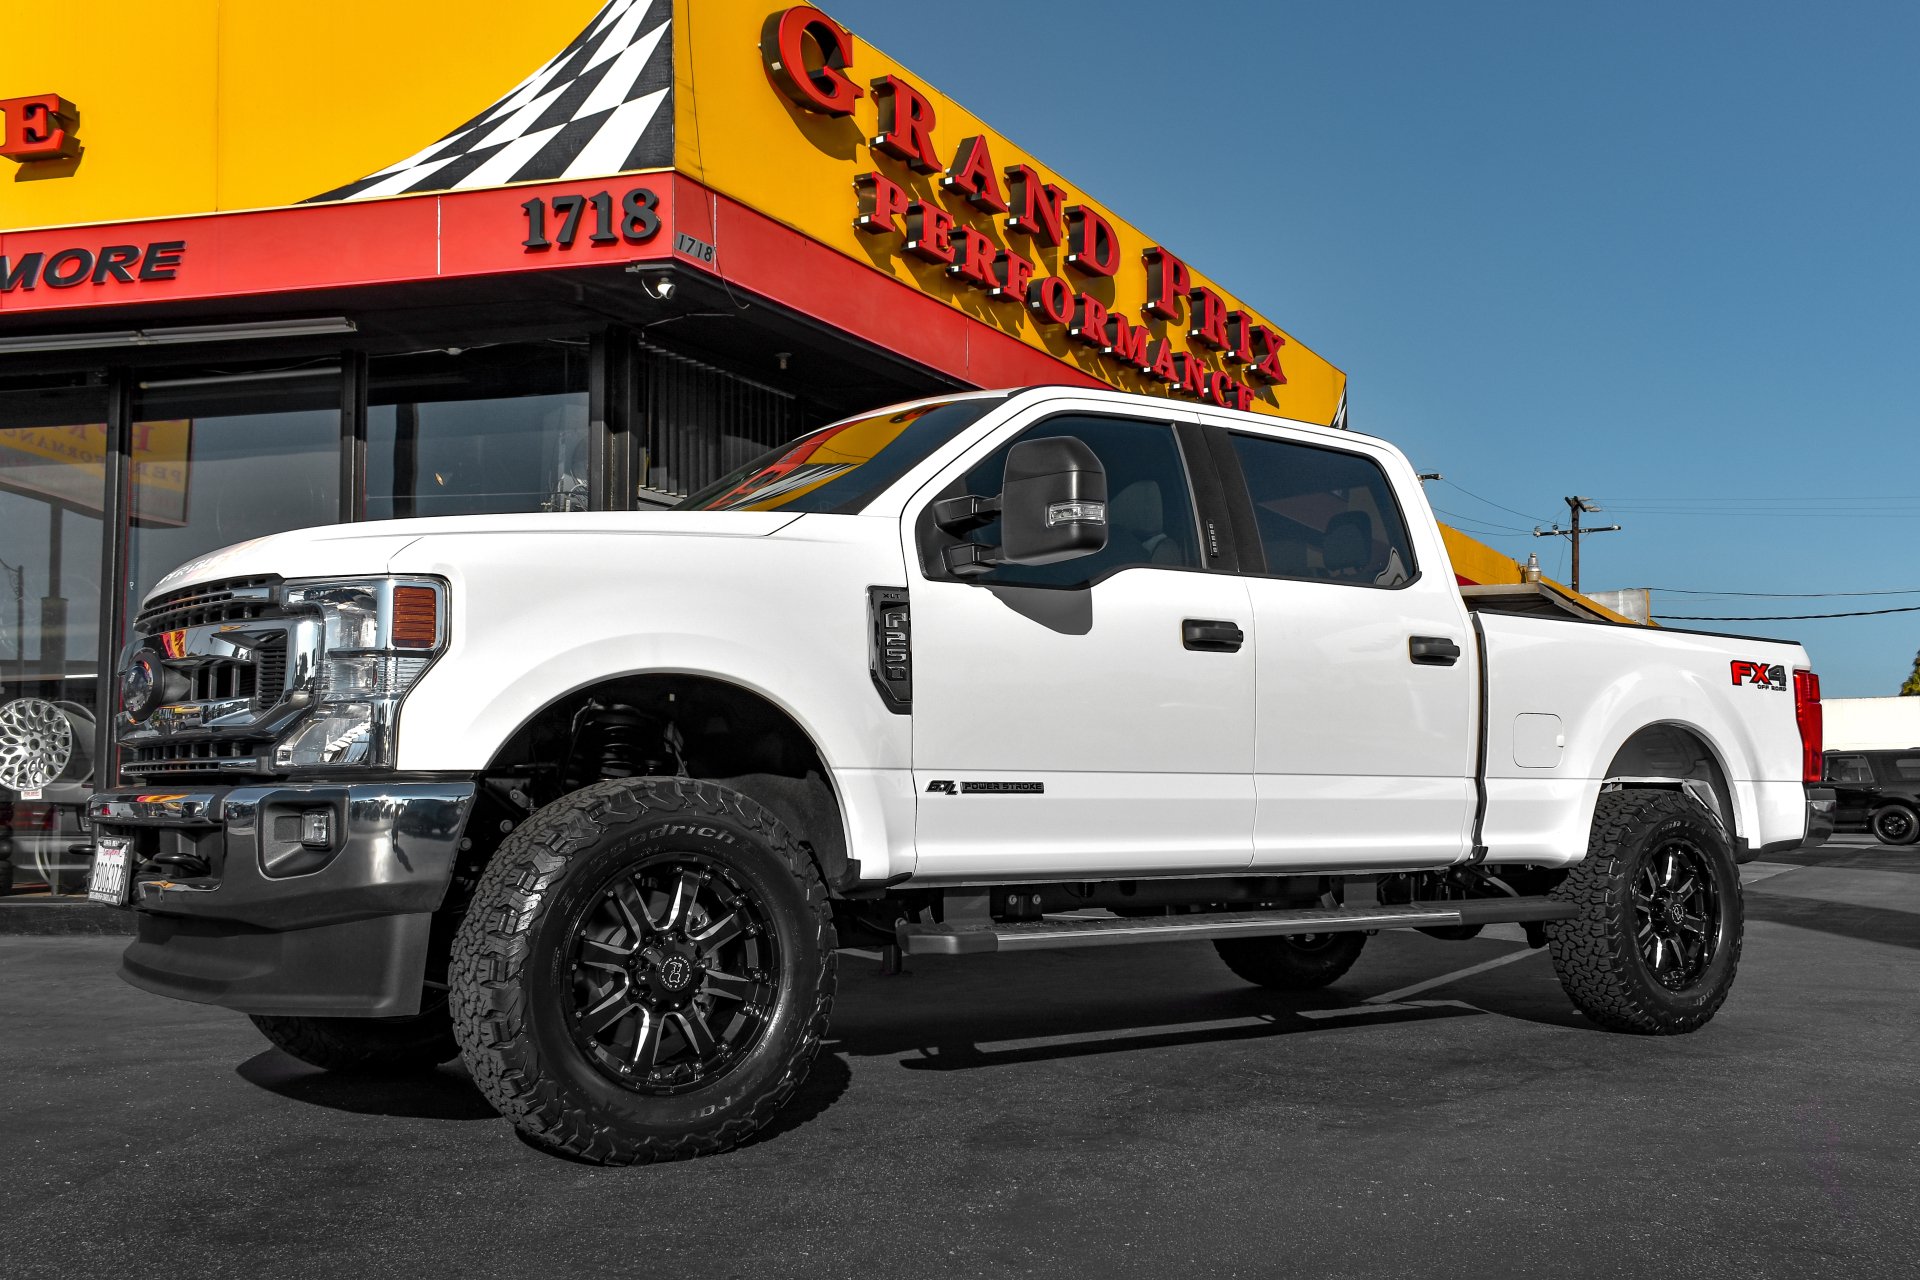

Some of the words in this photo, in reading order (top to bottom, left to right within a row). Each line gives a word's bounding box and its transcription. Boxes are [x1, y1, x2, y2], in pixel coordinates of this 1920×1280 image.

[0, 93, 78, 162] E
[521, 188, 662, 248] 1718
[761, 5, 1122, 278] GRAND
[1143, 245, 1288, 386] PRIX
[0, 240, 187, 291] MORE
[677, 233, 714, 263] 1718
[853, 171, 1255, 412] PERFORMANCE
[1730, 660, 1787, 686] FX4
[964, 782, 1000, 790] POWER
[1002, 782, 1042, 790] STROKE
